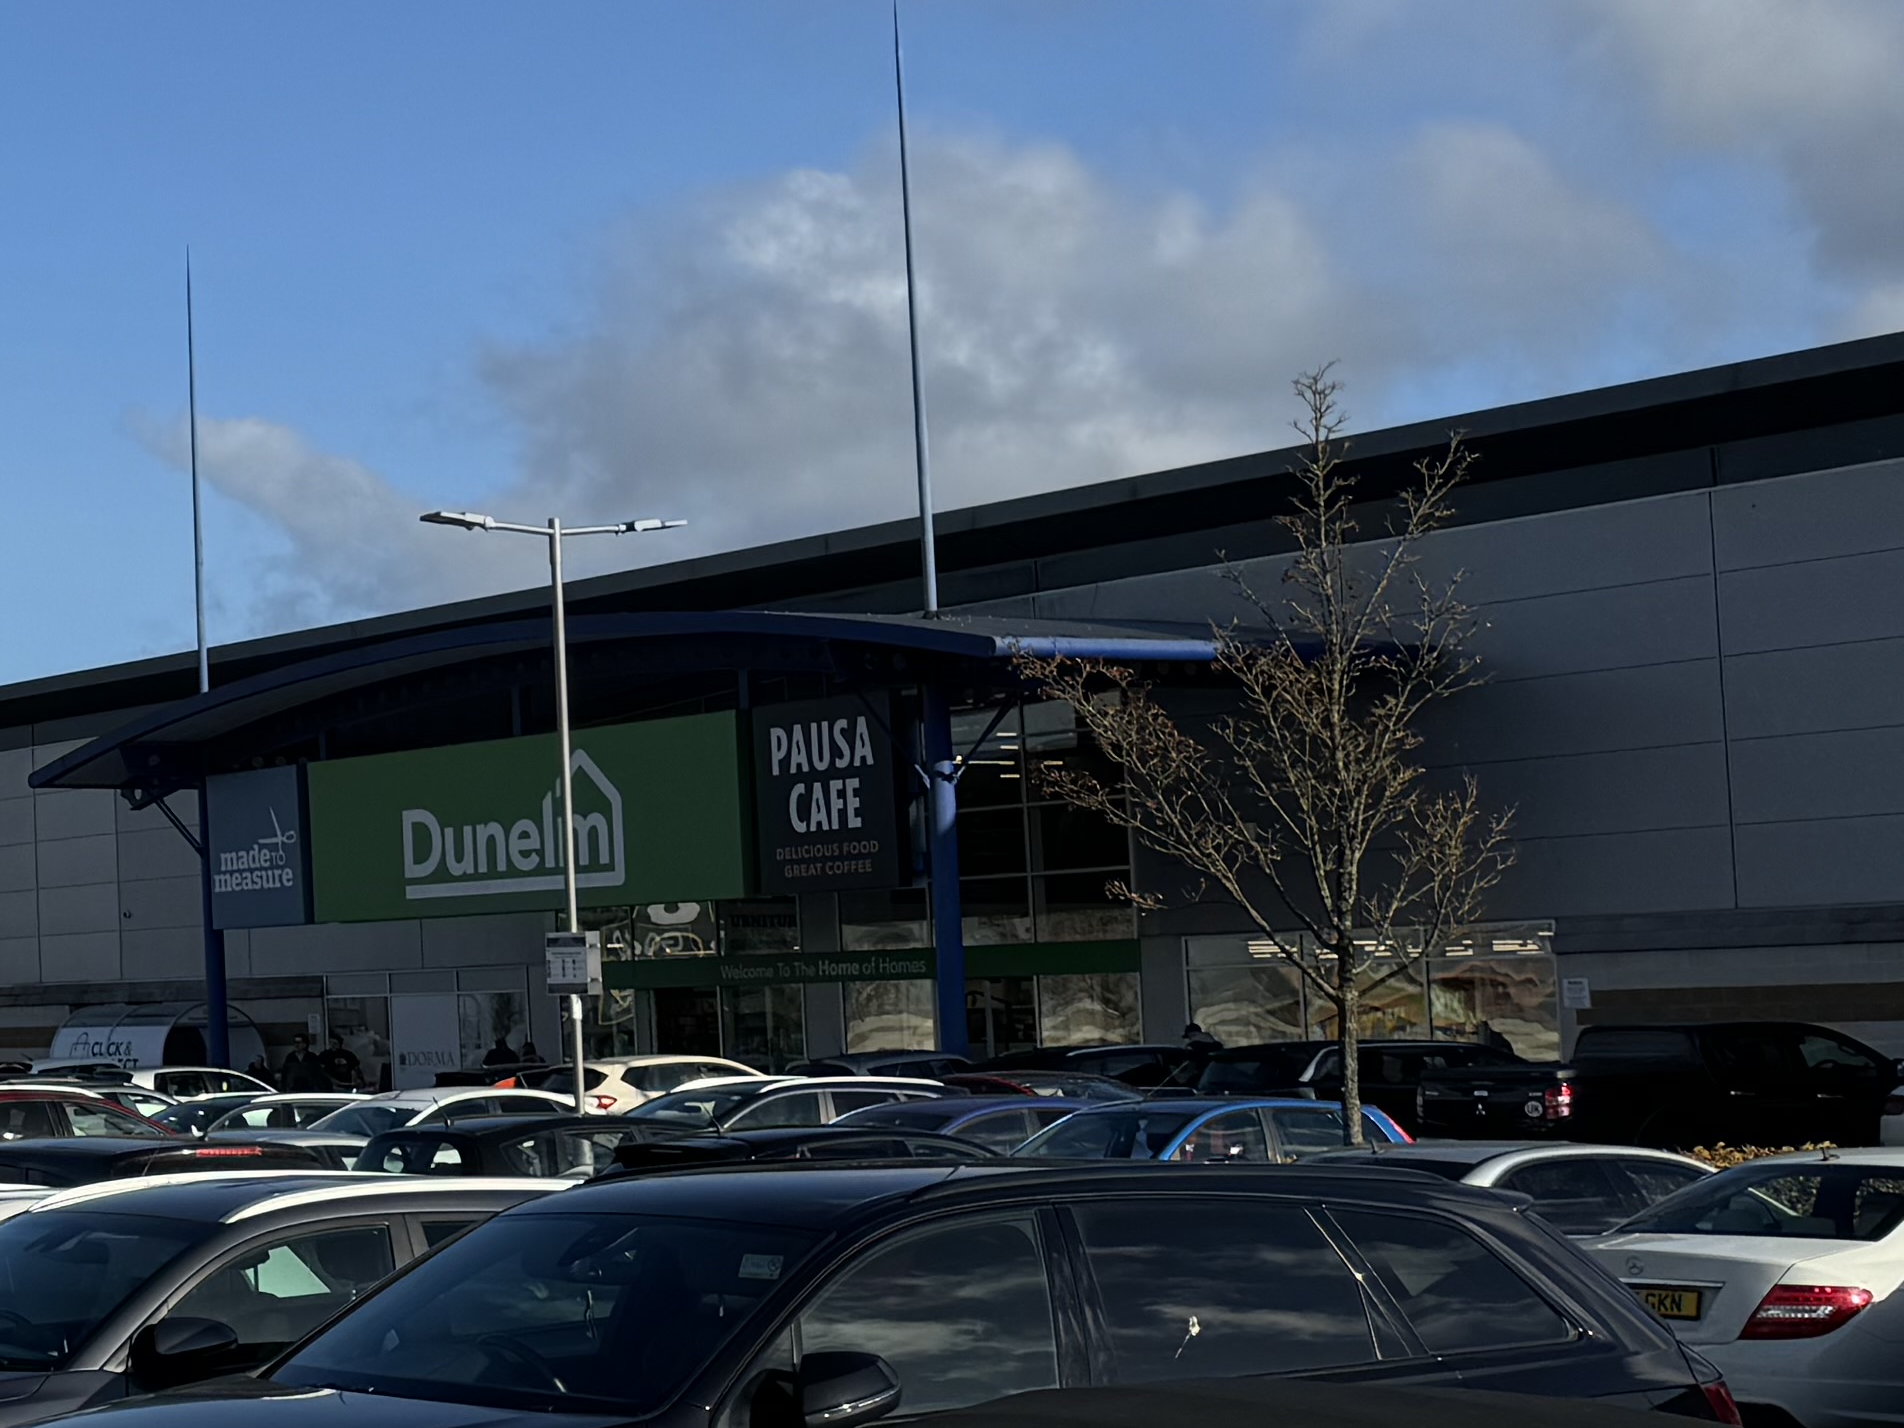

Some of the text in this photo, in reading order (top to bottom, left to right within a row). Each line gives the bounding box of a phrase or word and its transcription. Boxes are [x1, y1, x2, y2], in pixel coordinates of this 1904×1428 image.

[770, 716, 874, 776] PAUSA
[789, 777, 862, 833] CAFE
[402, 790, 610, 879] Dunelm
[220, 843, 286, 871] made TO
[776, 840, 879, 860] DELICIOUS FOOD
[213, 868, 294, 892] measure
[784, 859, 872, 878] GREAT COFFEE
[719, 956, 927, 980] Welcome To The Home of Homes
[407, 1052, 455, 1066] DORMA
